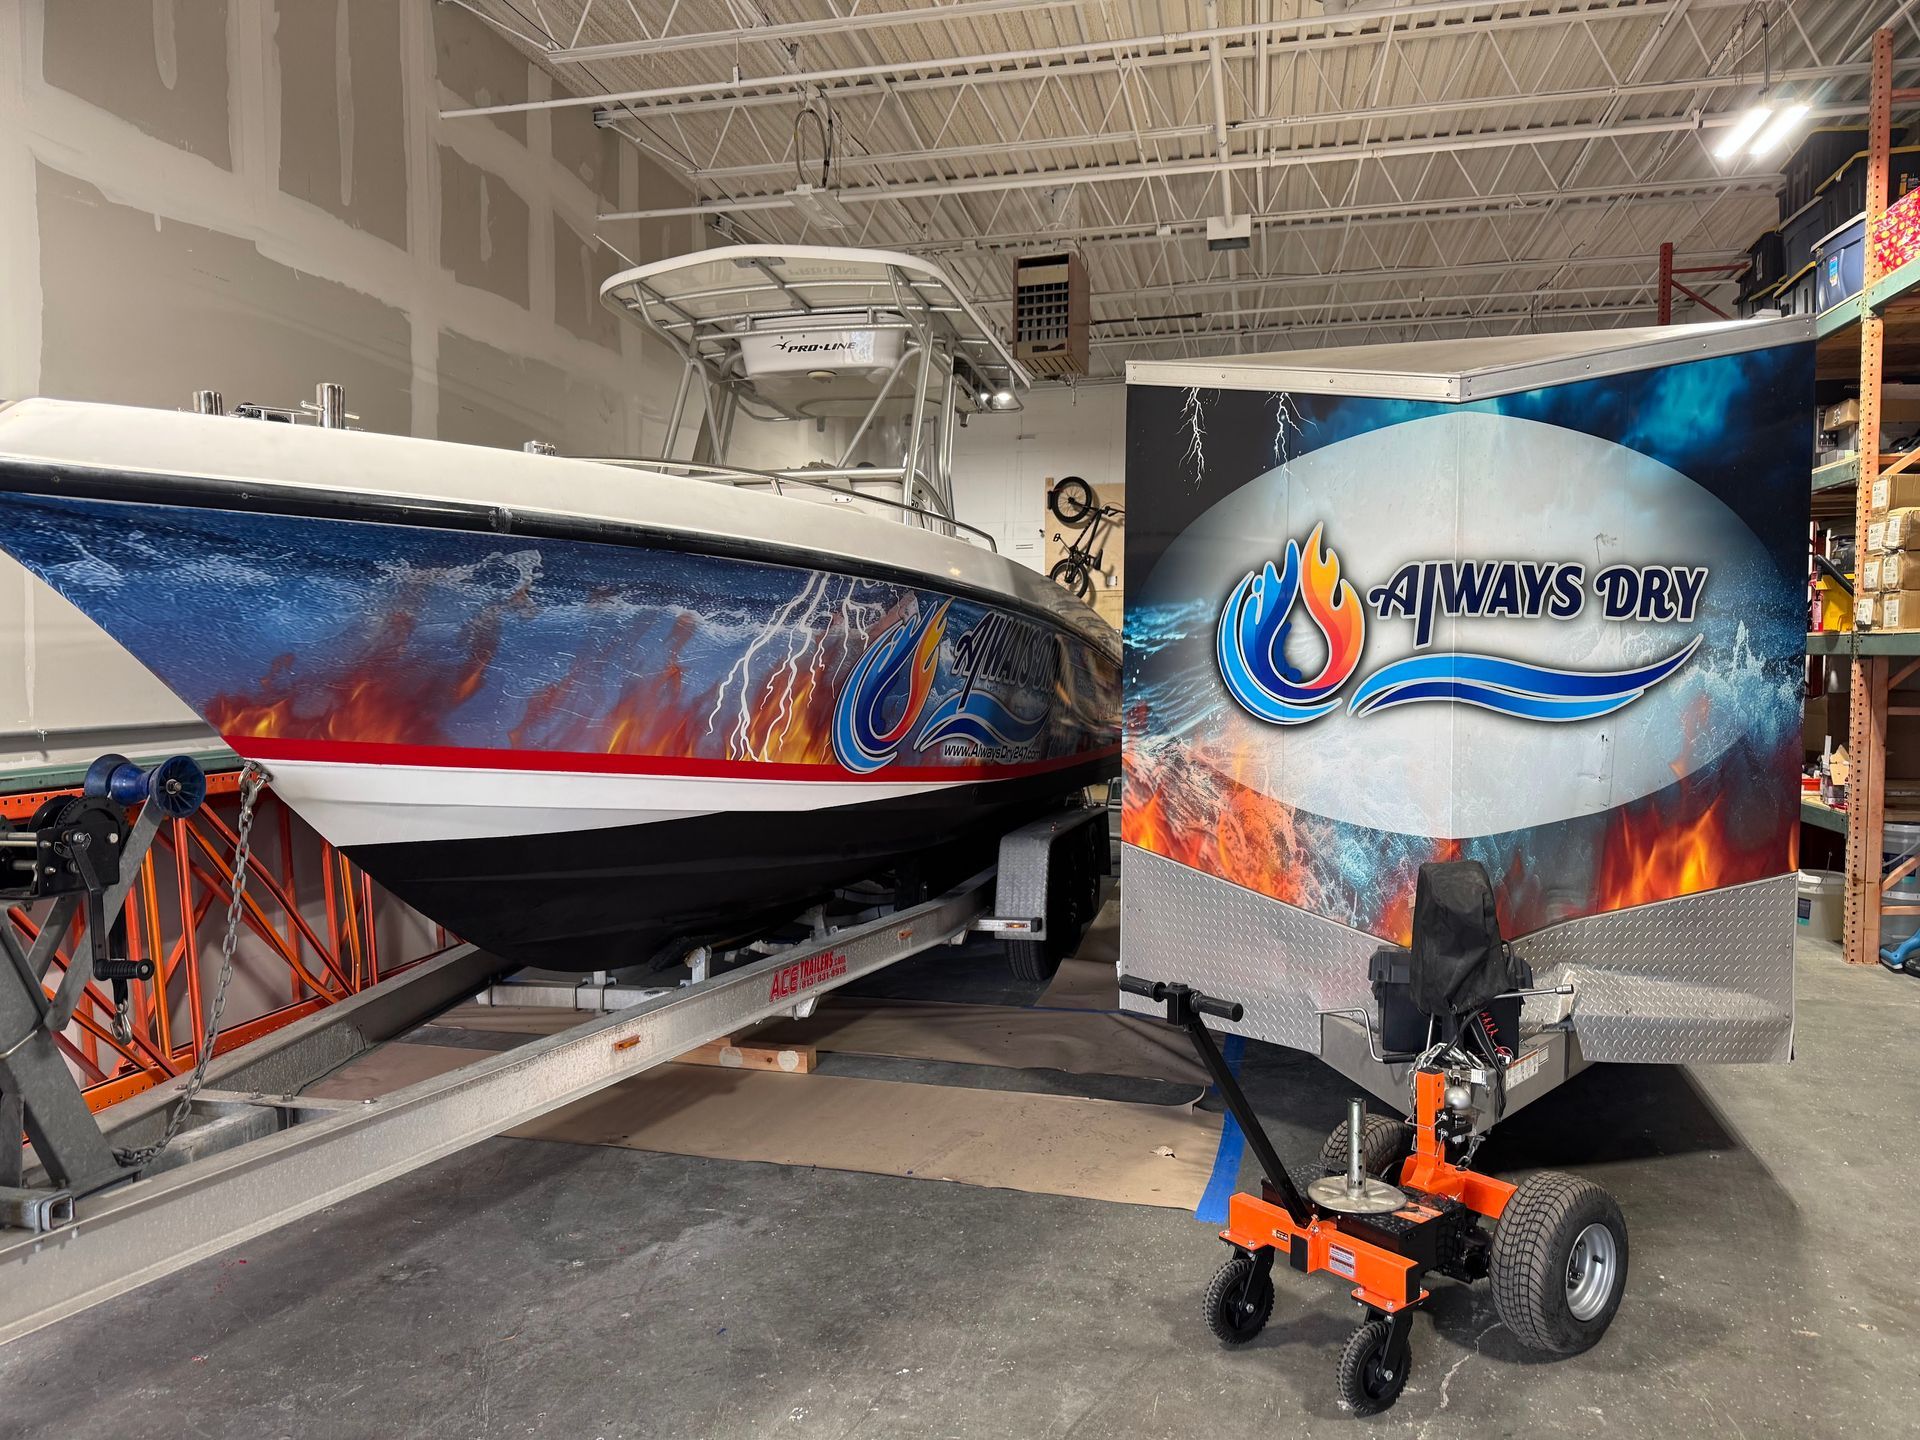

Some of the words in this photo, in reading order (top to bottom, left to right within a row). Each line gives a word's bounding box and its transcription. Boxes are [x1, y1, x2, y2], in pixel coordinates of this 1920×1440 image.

[1593, 565, 1709, 622] DRY
[943, 743, 1041, 762] www.AlwaysDry247.com
[769, 964, 799, 1003] ACE
